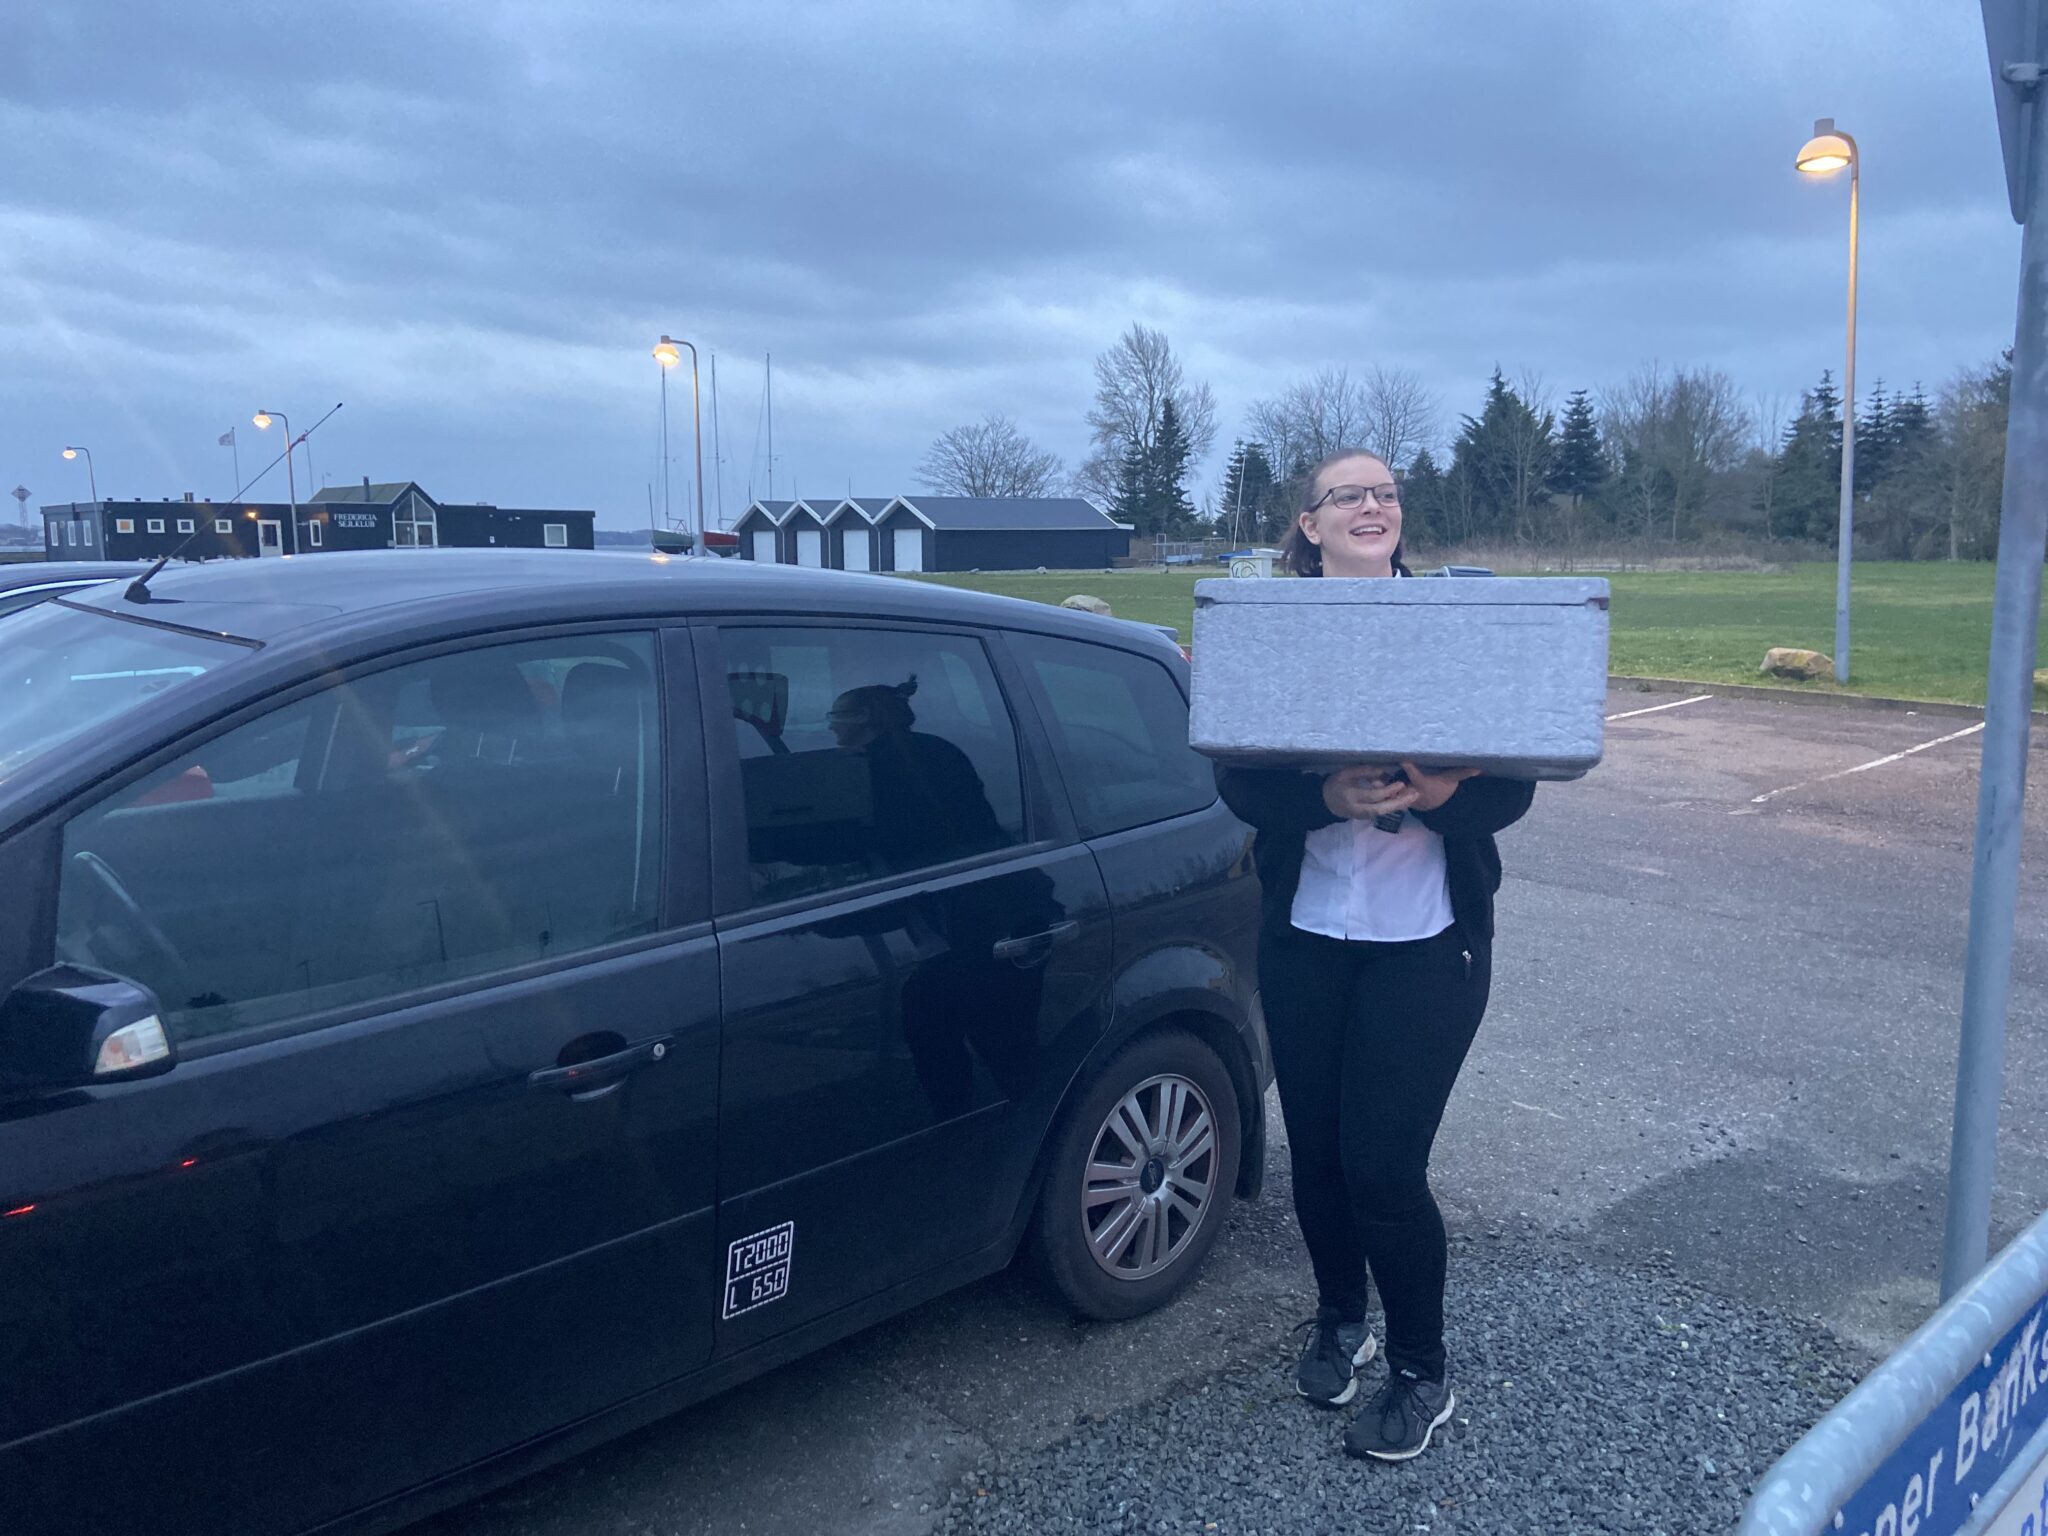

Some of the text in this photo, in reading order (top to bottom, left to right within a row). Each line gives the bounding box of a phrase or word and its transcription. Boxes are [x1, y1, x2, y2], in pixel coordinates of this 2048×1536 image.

[333, 513, 378, 521] FREDERICIA
[734, 1230, 789, 1272] T2000
[729, 1266, 786, 1310] L 650
